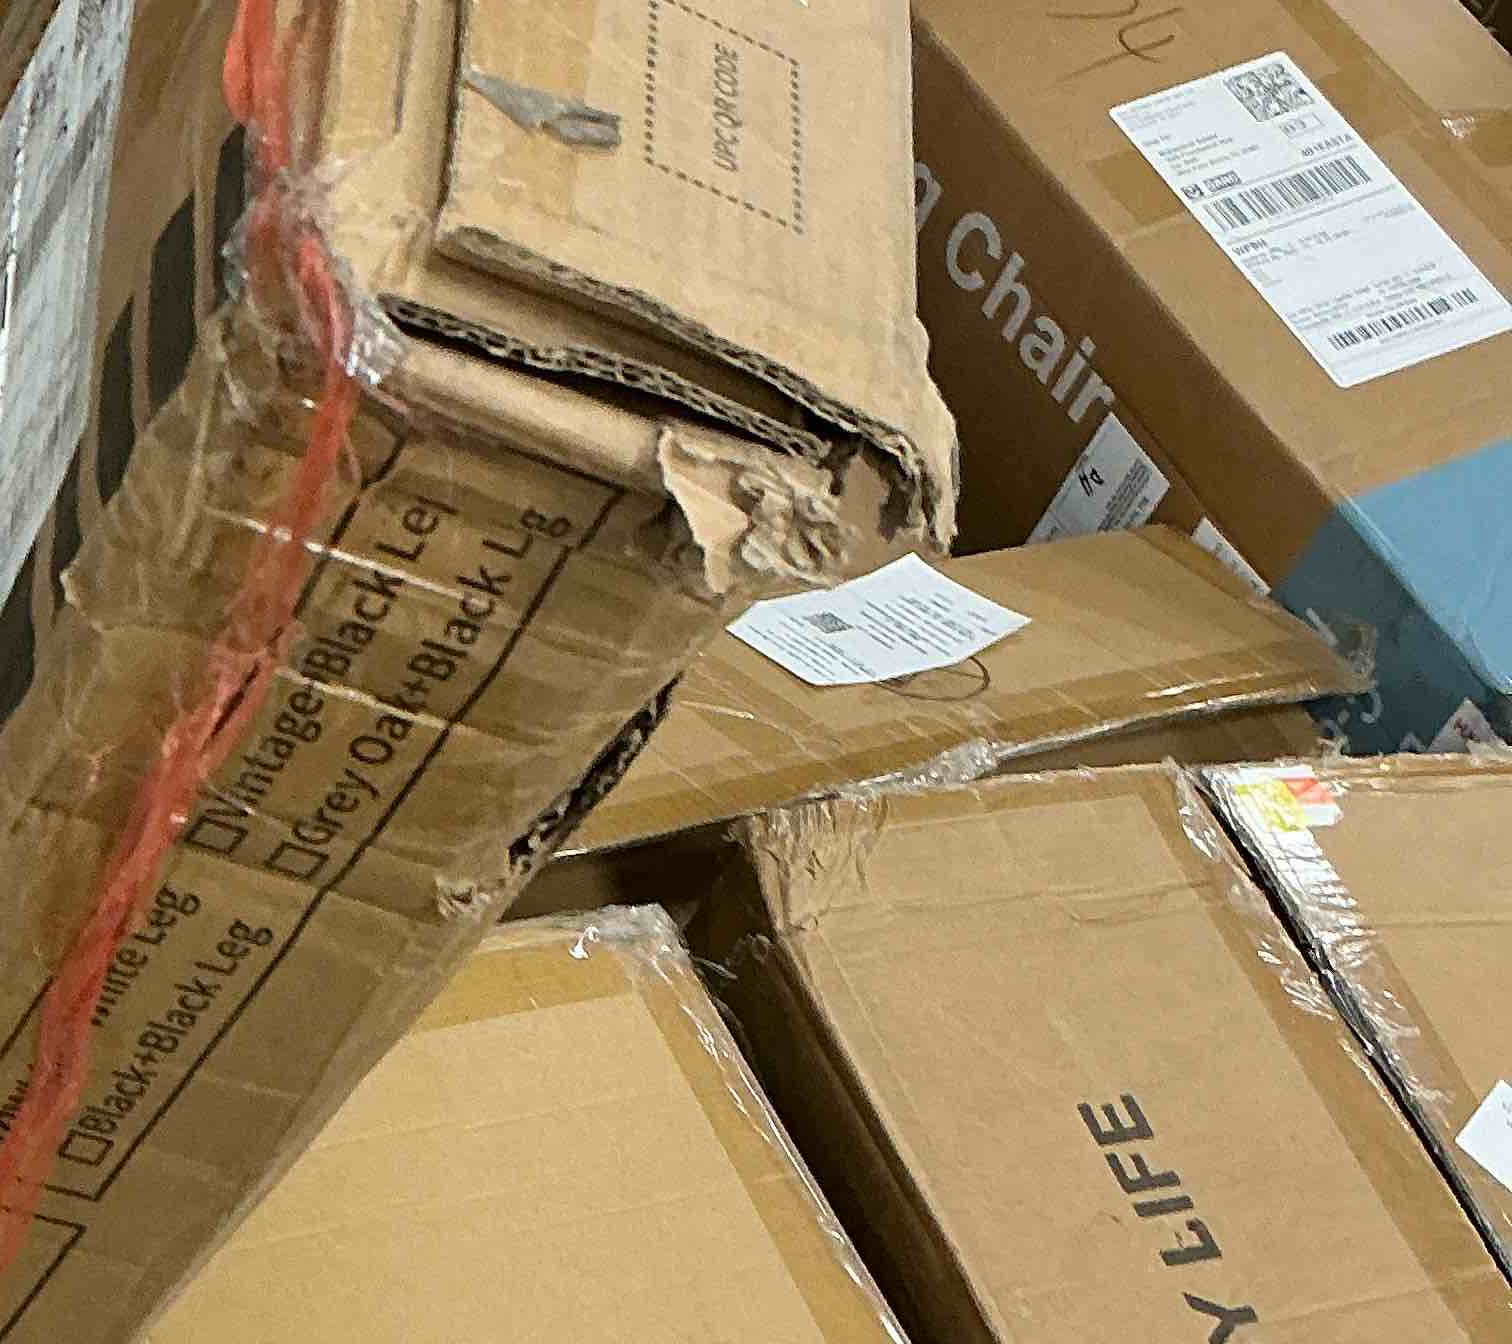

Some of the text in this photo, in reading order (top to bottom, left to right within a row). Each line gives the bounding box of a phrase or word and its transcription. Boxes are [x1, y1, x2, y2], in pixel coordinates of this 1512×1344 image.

[713, 44, 740, 173] UPC QR CODE
[944, 210, 1118, 423] Chair
[291, 768, 380, 849] Grey
[140, 887, 201, 948] Leg
[85, 973, 221, 1137] Black+Black
[214, 916, 275, 978] Leg
[1077, 1091, 1223, 1267] LIFE
